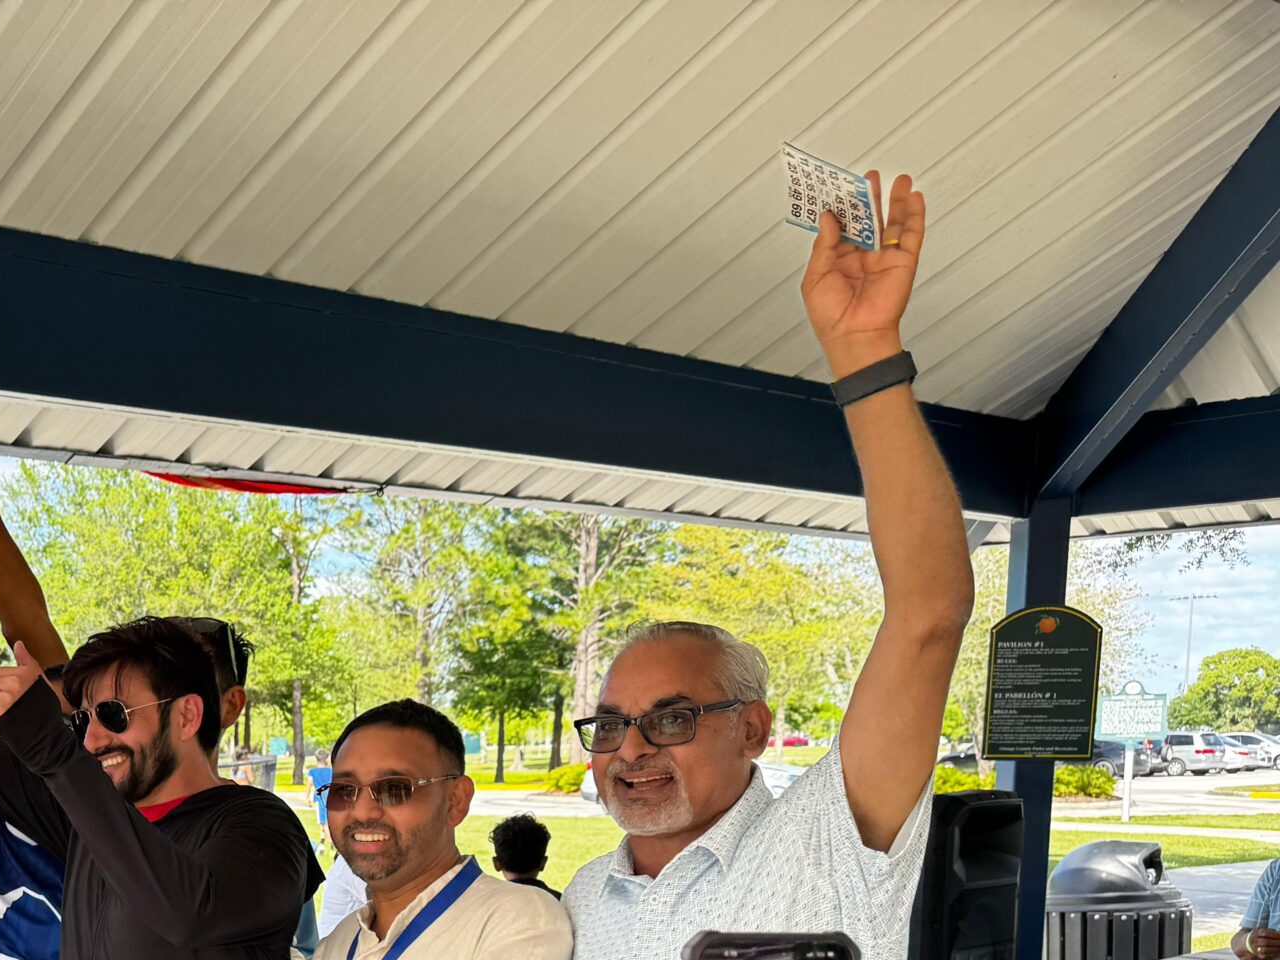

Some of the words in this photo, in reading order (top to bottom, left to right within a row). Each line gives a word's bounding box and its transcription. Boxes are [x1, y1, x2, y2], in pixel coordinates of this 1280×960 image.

[806, 193, 818, 207] 55
[791, 203, 803, 218] 69
[806, 208, 818, 224] 67
